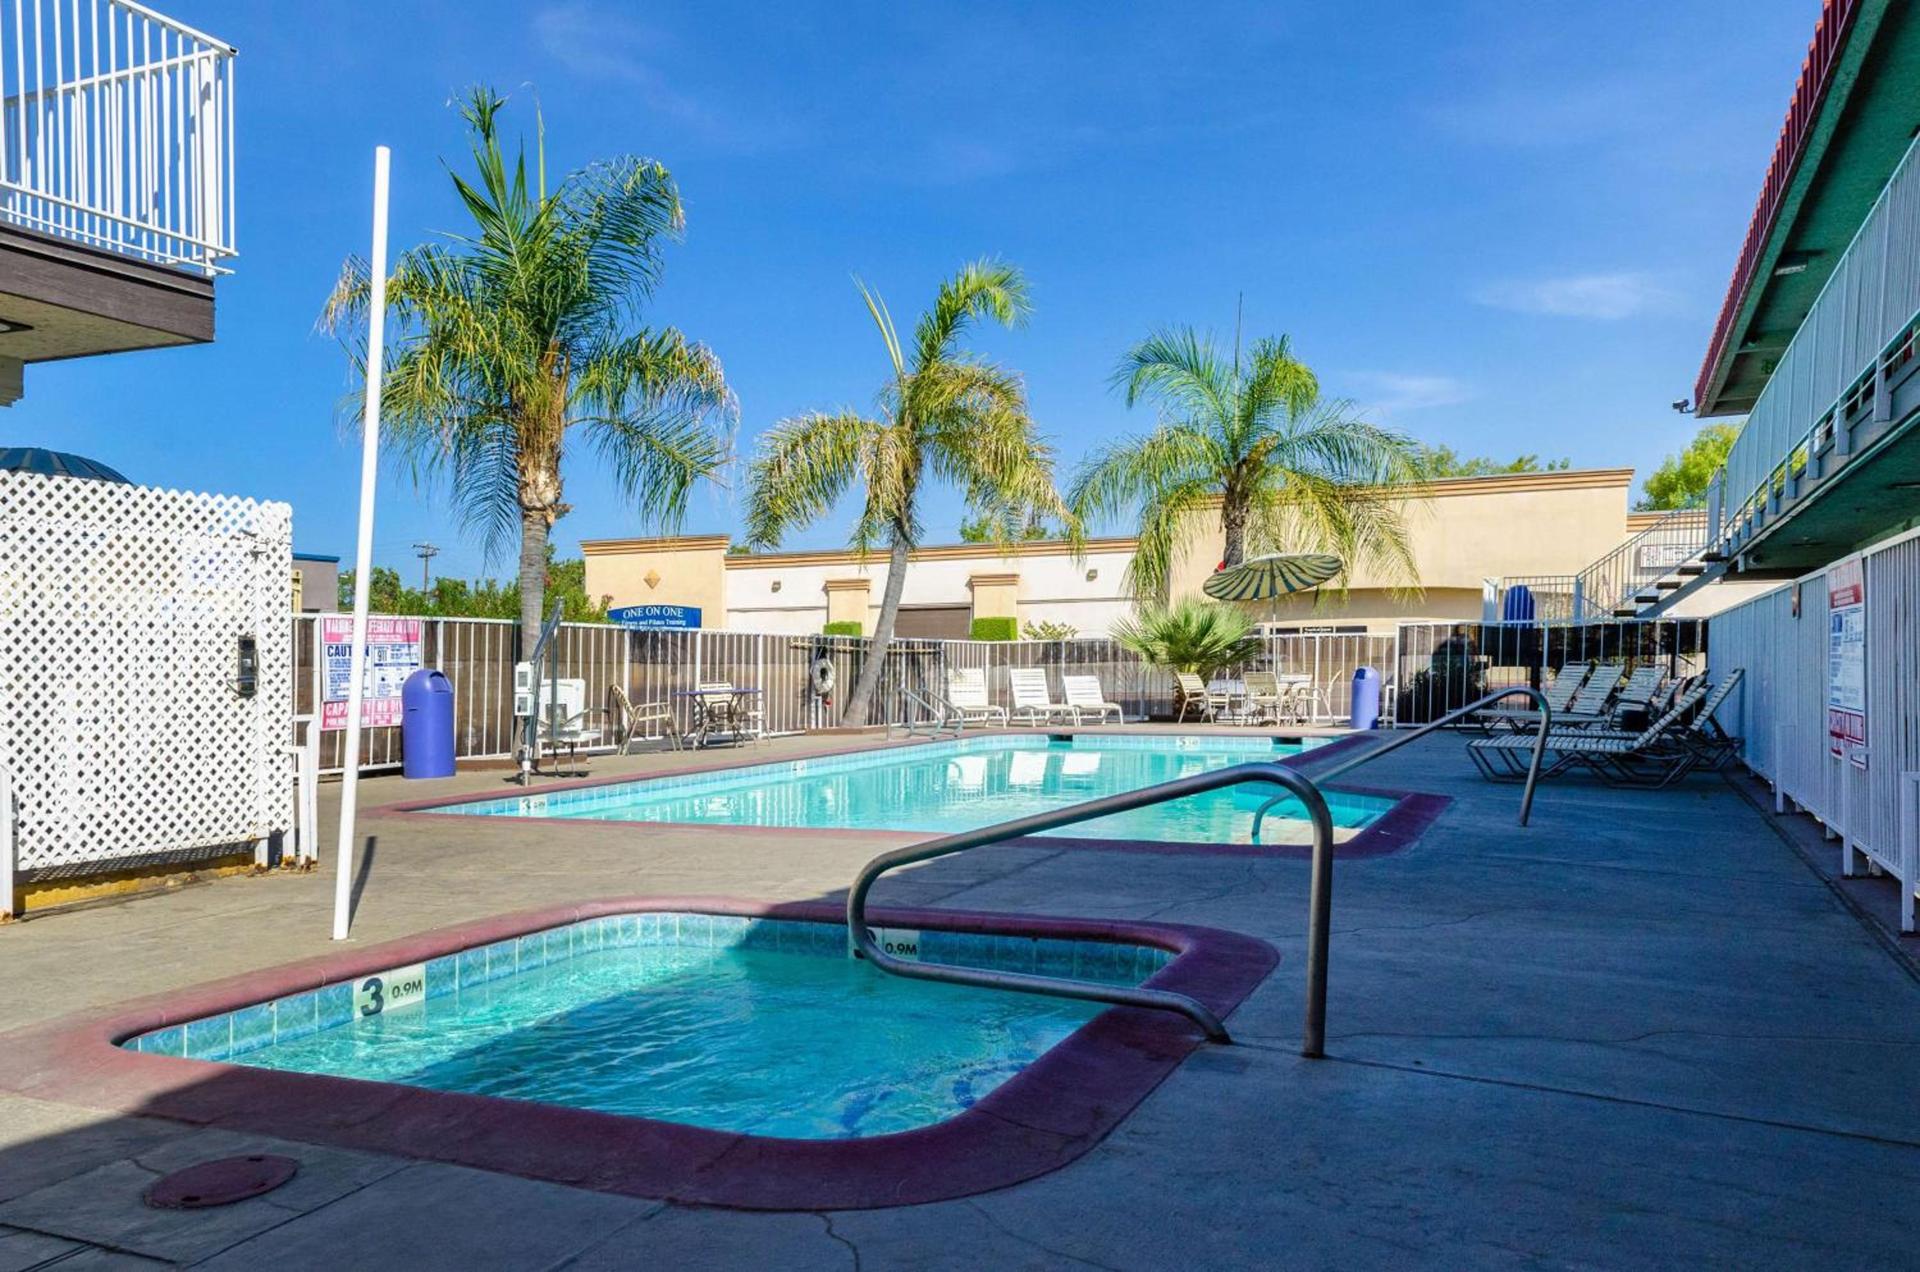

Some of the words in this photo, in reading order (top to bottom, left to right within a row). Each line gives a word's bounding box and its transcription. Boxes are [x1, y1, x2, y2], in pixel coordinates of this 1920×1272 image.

[623, 607, 644, 619] ONE
[645, 606, 660, 616] ON
[662, 607, 683, 617] ONE
[327, 645, 370, 657] CAUTN
[885, 942, 917, 955] 0.9M
[360, 977, 384, 1016] 3
[392, 979, 422, 999] 0.9M
